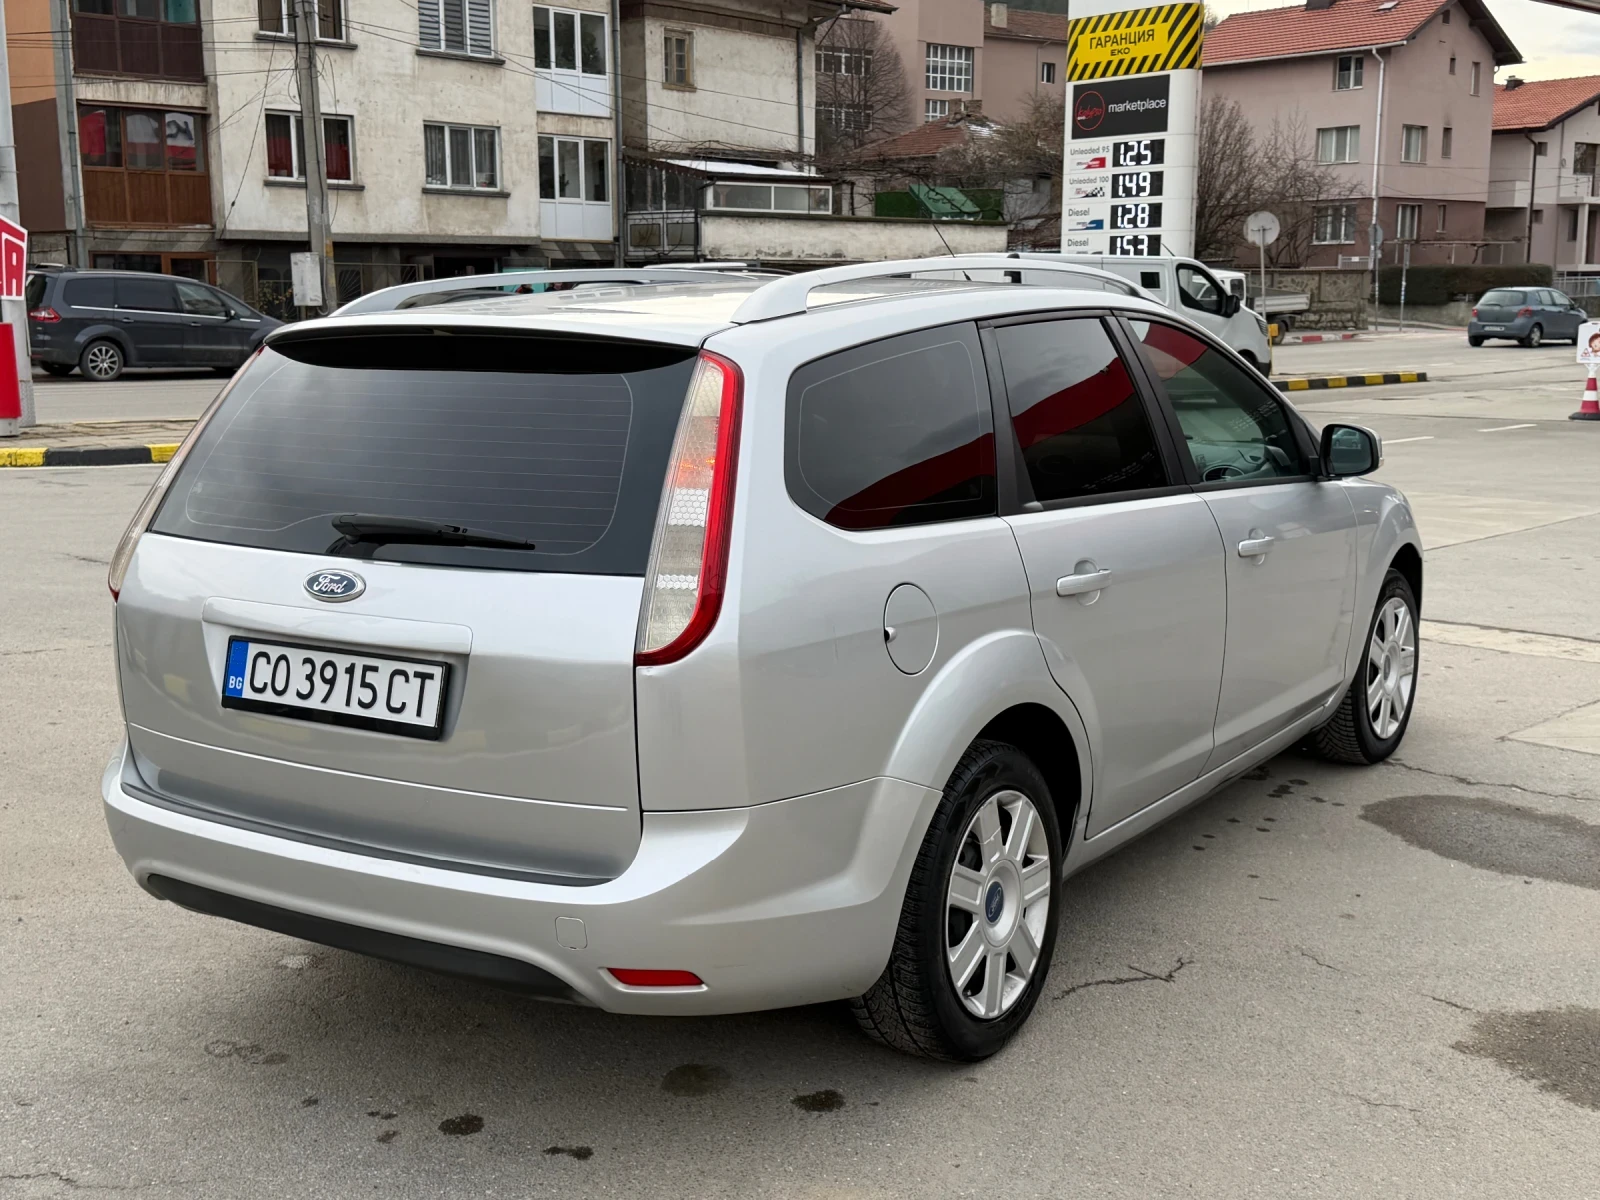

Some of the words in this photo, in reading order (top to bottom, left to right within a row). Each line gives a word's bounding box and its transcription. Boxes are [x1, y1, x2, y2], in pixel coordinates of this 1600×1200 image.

[1089, 29, 1155, 50] ГАРАНЦИЯ
[1108, 98, 1166, 113] marketplace
[1070, 147, 1100, 156] Unleaded
[1101, 145, 1110, 153] 95
[1119, 140, 1152, 166] 1.25
[1069, 176, 1097, 185] Unleaded
[1099, 175, 1109, 183] 100
[1118, 172, 1151, 197] 1.49
[1068, 208, 1090, 217] Diesel
[1117, 203, 1149, 228] 1.28
[1067, 238, 1089, 247] Diesel
[313, 574, 348, 593] Ford
[228, 676, 243, 689] BG
